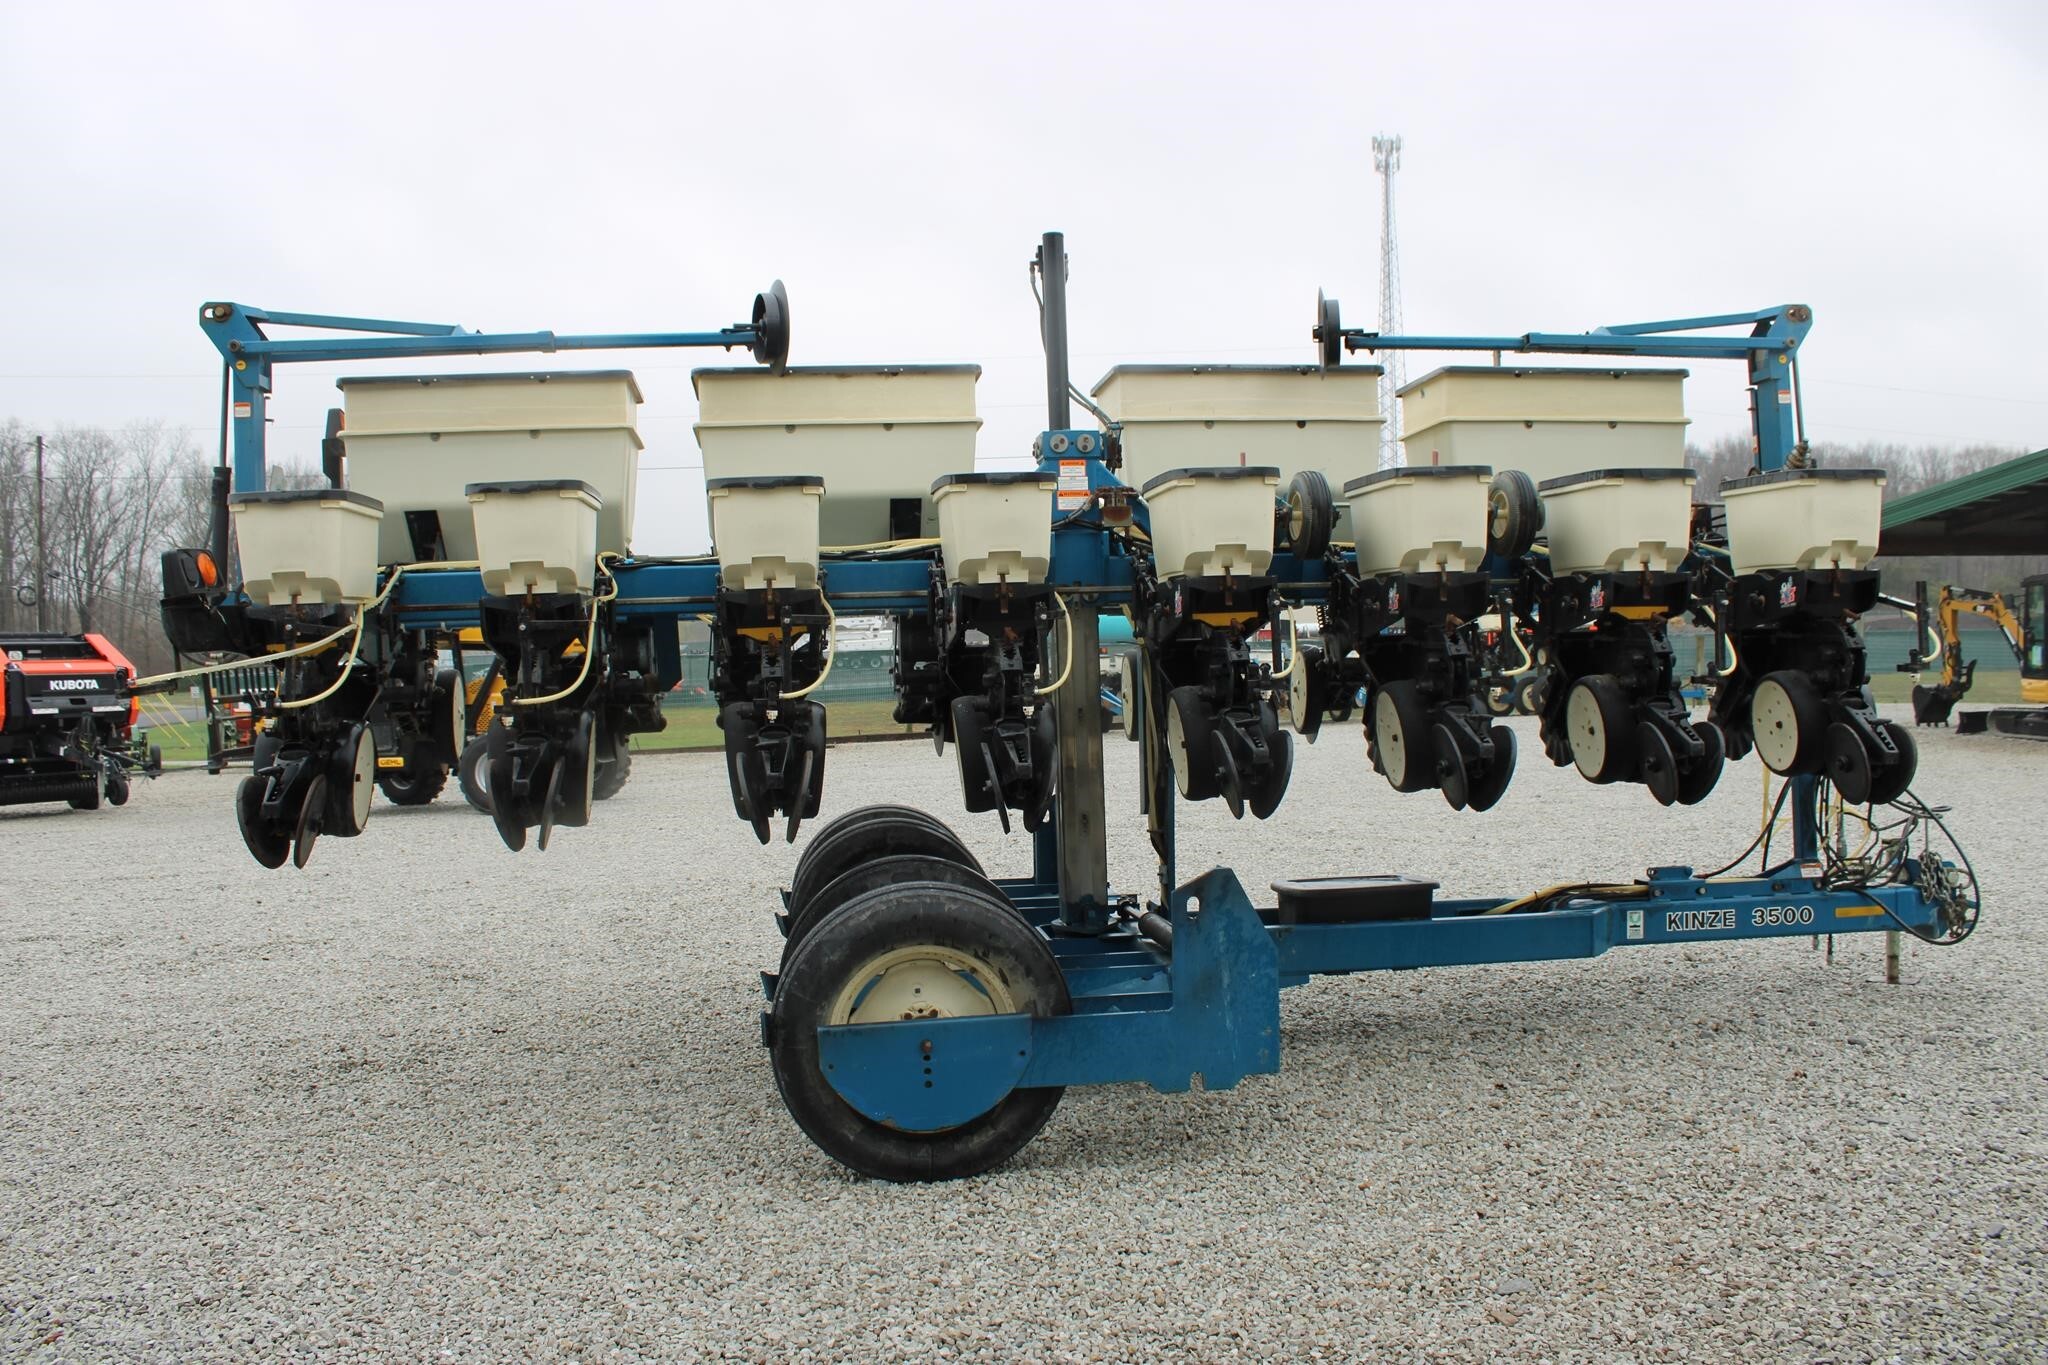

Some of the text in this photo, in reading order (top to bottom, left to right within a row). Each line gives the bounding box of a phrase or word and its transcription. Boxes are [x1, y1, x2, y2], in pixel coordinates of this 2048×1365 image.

[49, 679, 99, 690] KUBOTA
[1666, 909, 1736, 931] KINZE
[1752, 905, 1814, 926] 3500
